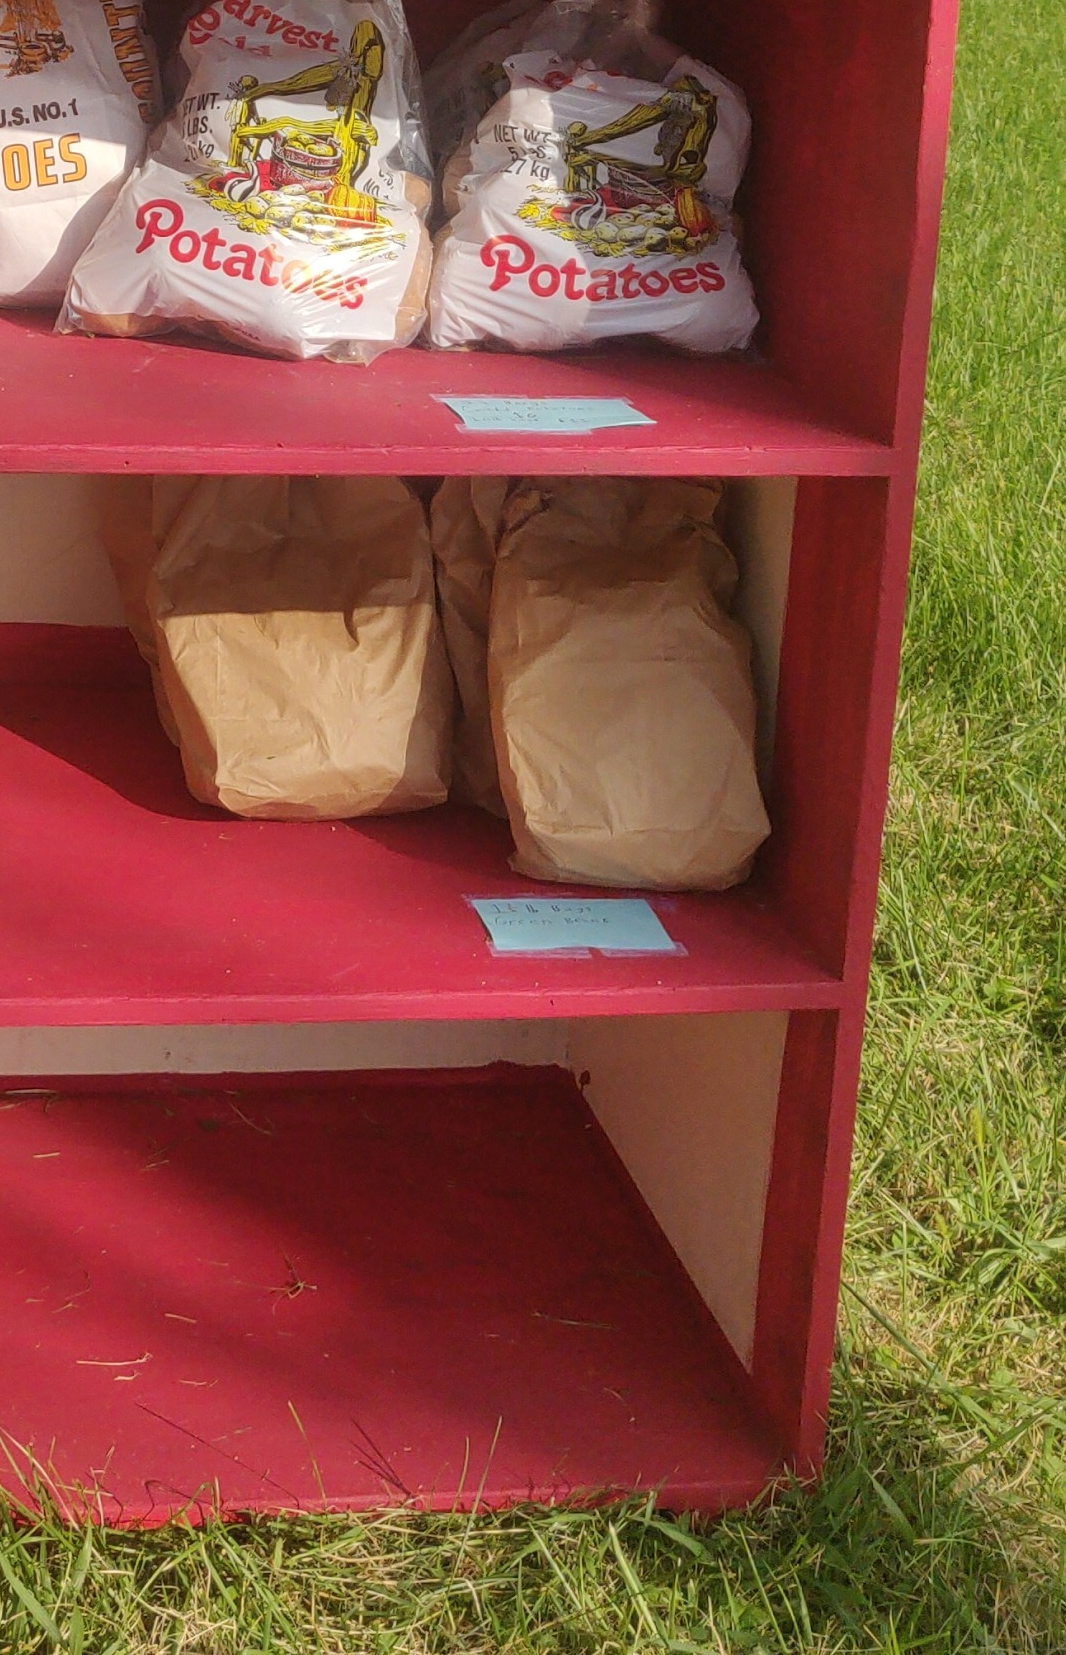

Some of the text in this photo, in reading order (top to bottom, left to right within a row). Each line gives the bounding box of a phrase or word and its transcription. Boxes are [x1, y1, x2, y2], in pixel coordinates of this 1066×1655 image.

[32, 101, 67, 123] NO.
[68, 97, 80, 117] 1
[493, 124, 519, 144] NET
[530, 159, 551, 182] kg
[135, 198, 368, 311] Potatoes
[480, 234, 726, 302] Potatoes
